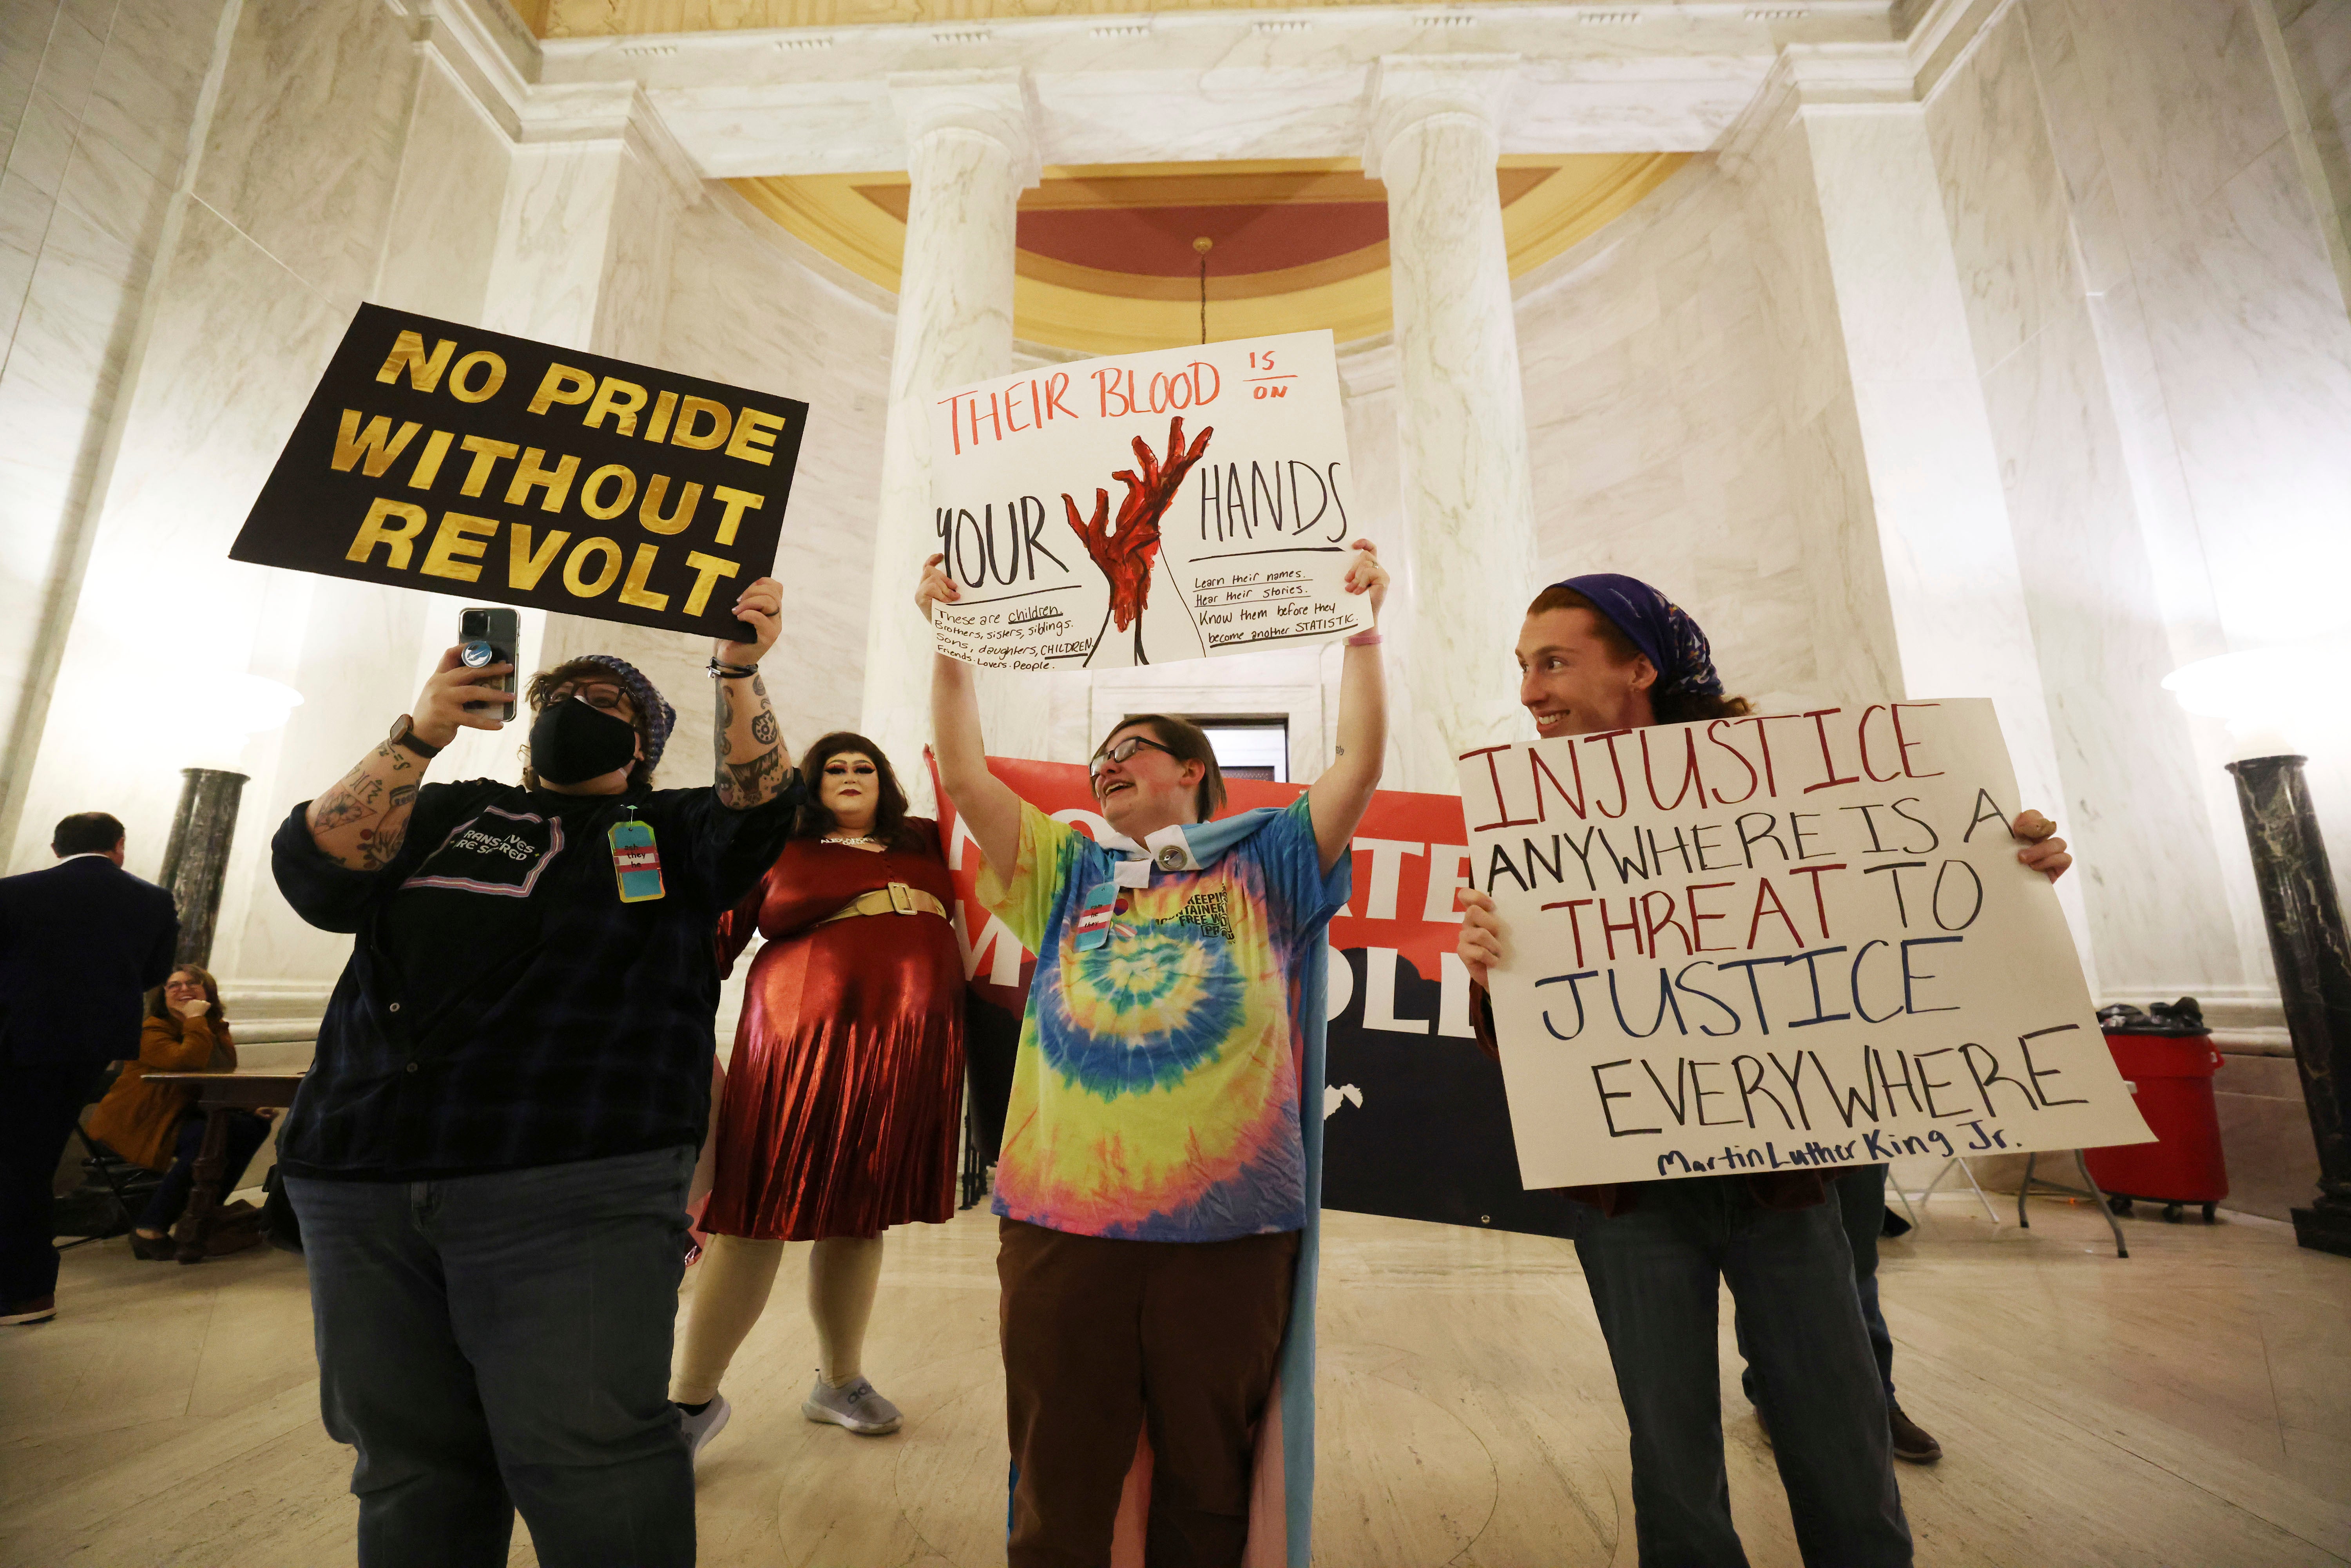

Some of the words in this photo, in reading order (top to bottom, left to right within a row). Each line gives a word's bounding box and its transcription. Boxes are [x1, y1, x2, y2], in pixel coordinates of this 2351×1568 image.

[1249, 350, 1276, 370] IS
[376, 330, 507, 402] NO
[527, 362, 785, 466] PRIDE
[1254, 384, 1288, 400] ON
[937, 372, 1079, 455] THEIR
[1090, 359, 1220, 418] BLOOD
[331, 408, 764, 546] WITHOUT
[937, 496, 1069, 588] YOUR
[1201, 460, 1347, 543] HANDS
[345, 498, 740, 617] REVOLT
[1195, 577, 1224, 588] Learn
[1233, 573, 1259, 584] their
[1267, 570, 1305, 581] names.
[1197, 594, 1217, 606] Hear
[1226, 590, 1252, 601] their
[935, 608, 975, 625] These
[980, 614, 1000, 625] are
[1008, 605, 1062, 623] children.
[1200, 610, 1232, 625] Know
[1241, 609, 1267, 621] them
[1277, 603, 1308, 617] before
[1315, 603, 1335, 614] they
[935, 620, 983, 639] Brothers,
[987, 628, 1024, 639] sisters,
[1029, 620, 1073, 636] siblings.
[1209, 631, 1244, 643] become
[1252, 627, 1290, 640] another
[1295, 614, 1358, 632] STATISTIC.
[936, 633, 973, 653] Sons,
[979, 645, 1038, 660] daughters,
[937, 645, 975, 661] Friends.
[977, 659, 1011, 668] Lovers.
[1014, 661, 1054, 671] People.
[1459, 703, 1945, 832] INJUSTICE
[452, 840, 478, 850] RE
[464, 830, 502, 846] RANS
[1487, 811, 1836, 896] ANYWHERE
[1840, 797, 1940, 855] IS
[1964, 788, 2014, 844] A
[627, 852, 646, 861] they
[1541, 864, 1847, 968] THREAT
[1864, 859, 1983, 931] TO
[1535, 936, 1964, 1041] JUSTICE
[1591, 1025, 2089, 1137] EVERYWHERE
[1657, 1144, 1764, 1176] Martin
[1765, 1140, 1856, 1169] Luther
[1863, 1128, 1954, 1161] King
[1956, 1119, 2022, 1151] Jr.
